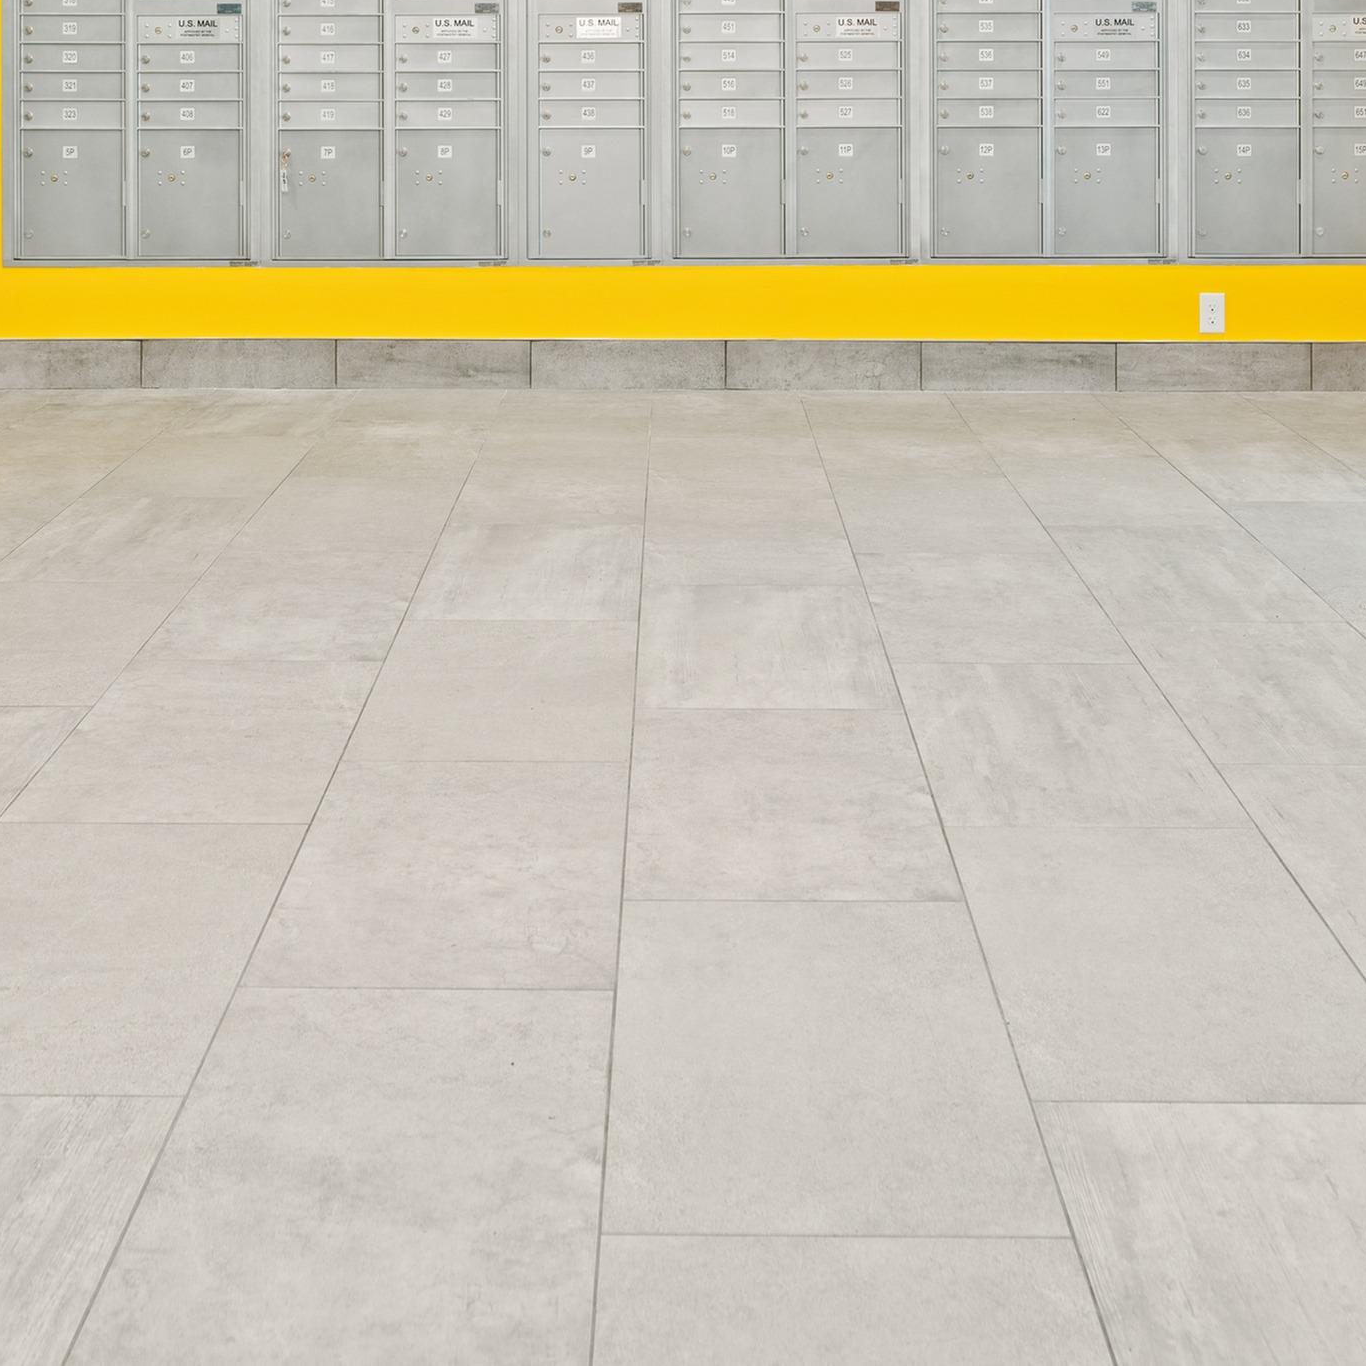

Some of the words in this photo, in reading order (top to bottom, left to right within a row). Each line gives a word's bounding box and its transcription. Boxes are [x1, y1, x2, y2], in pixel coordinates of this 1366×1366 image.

[435, 19, 452, 27] U.S.
[454, 19, 475, 27] MAIL
[597, 19, 619, 27] MAIL
[838, 18, 855, 26] U.S.
[856, 18, 877, 26] MAIL
[979, 21, 993, 31] 535
[1095, 18, 1113, 27] U.S.
[1114, 18, 1135, 27] MAIL
[1237, 22, 1251, 31] 633
[322, 53, 335, 61] 417
[438, 52, 451, 62] 427
[1097, 50, 1110, 59] 549
[1237, 50, 1251, 60] 634
[64, 81, 76, 90] 321
[180, 81, 194, 90] 407
[980, 78, 993, 89] 537
[1237, 79, 1251, 89] 635
[63, 109, 77, 119] 323
[438, 109, 452, 119] 429
[839, 107, 852, 117] 527
[1238, 107, 1251, 117] 636
[65, 147, 75, 157] 5P
[323, 148, 333, 157] 7P
[583, 146, 594, 156] 9P
[722, 146, 736, 155] 10P
[839, 145, 852, 154] 11P
[979, 145, 993, 154] 12P
[1096, 145, 1111, 154] 13P
[1236, 145, 1251, 154] 14P
